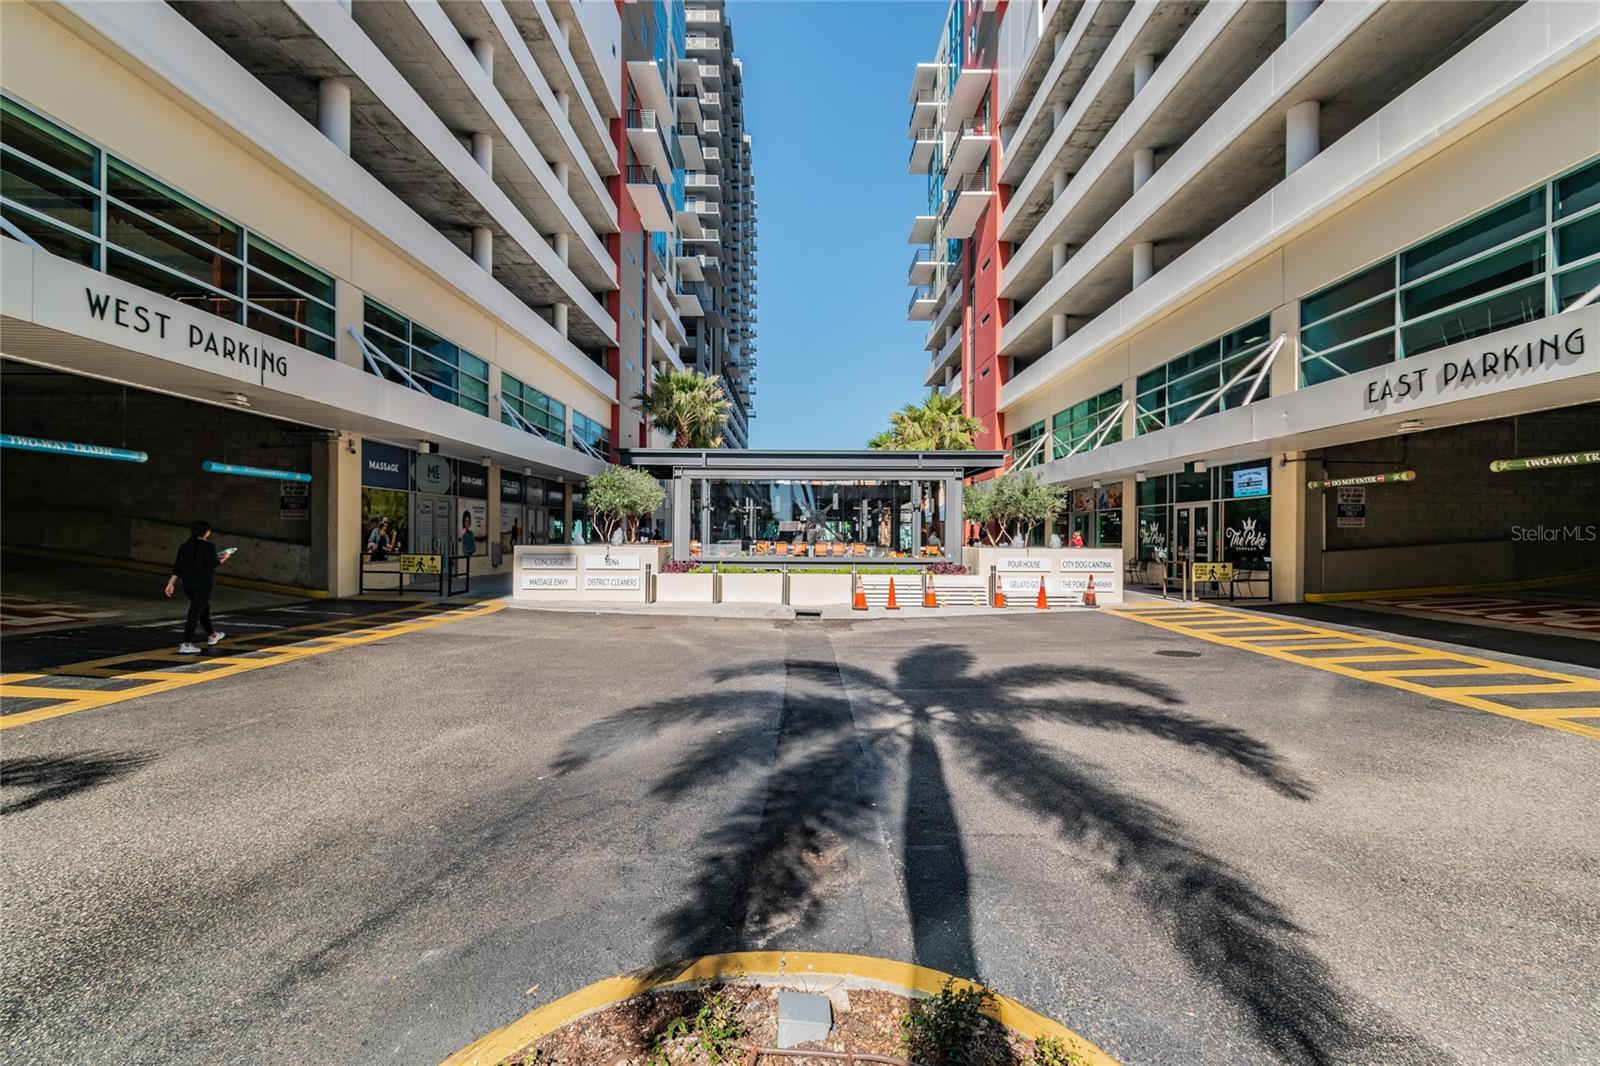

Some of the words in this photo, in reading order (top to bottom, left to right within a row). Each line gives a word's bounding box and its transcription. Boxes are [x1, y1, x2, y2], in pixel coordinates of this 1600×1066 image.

[86, 287, 171, 339] WEST
[189, 324, 288, 377] PARKING
[1368, 368, 1428, 403] EAST
[1444, 327, 1585, 386] PARKING
[9, 435, 68, 450] TWO-WAY
[1523, 454, 1579, 468] TWO-WAY
[368, 460, 399, 473] MASSAGE
[1341, 478, 1355, 486] NOT
[1355, 476, 1377, 484] ENTER
[1226, 527, 1245, 548] The
[534, 558, 565, 566] CONCIERGE
[1007, 560, 1023, 569] POUR
[1023, 560, 1040, 569] HOUSE
[1062, 560, 1074, 568] CITY
[1075, 560, 1088, 568] DOG
[1088, 560, 1112, 569] CANTINA
[587, 579, 610, 587] DISTRICT
[610, 579, 637, 587] CLEANERS
[1009, 580, 1030, 589] GELATO
[1030, 580, 1039, 589] GO
[1062, 580, 1070, 589] THE
